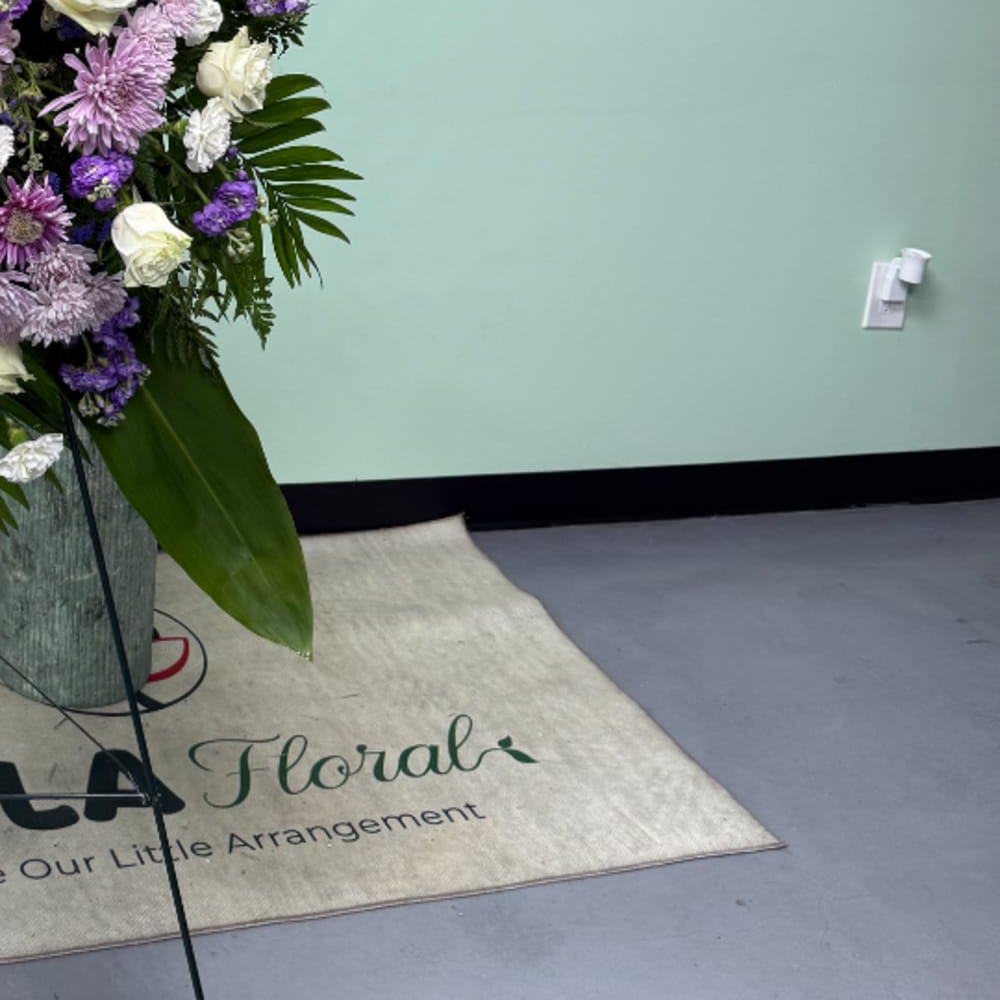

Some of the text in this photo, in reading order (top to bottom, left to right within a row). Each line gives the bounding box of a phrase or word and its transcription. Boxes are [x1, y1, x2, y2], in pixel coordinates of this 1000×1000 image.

[187, 713, 504, 810] Floral
[20, 854, 96, 880] Our
[227, 801, 487, 854] Arrangement
